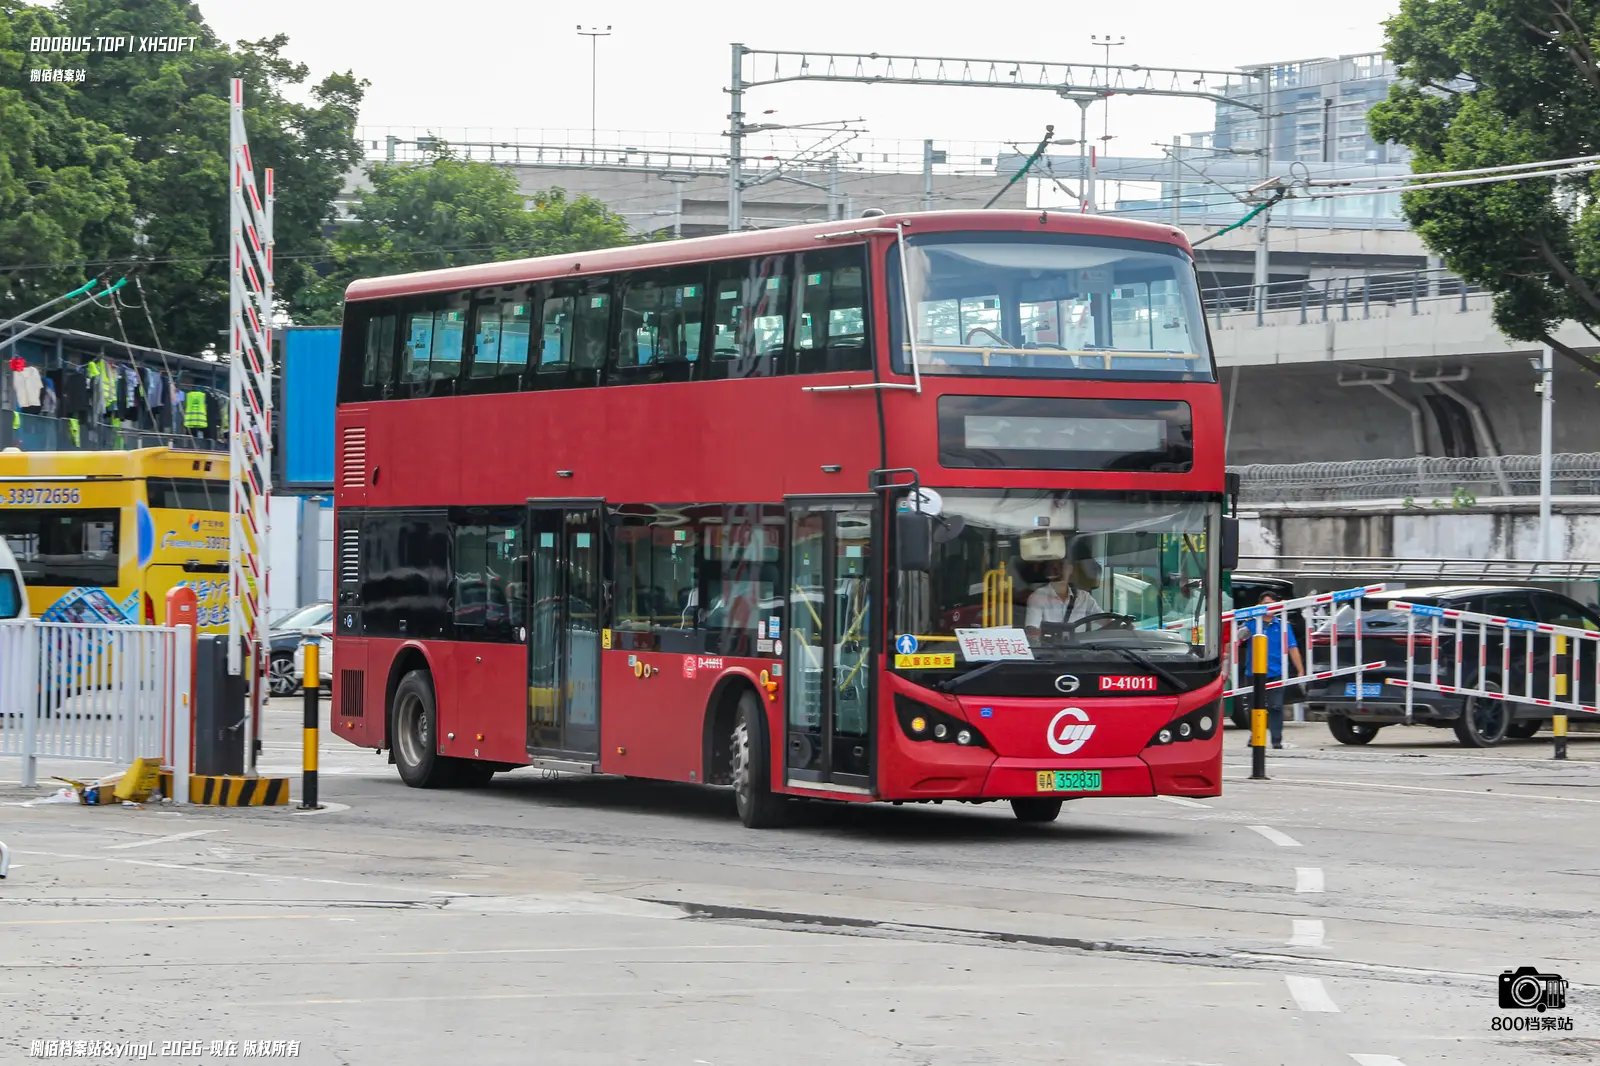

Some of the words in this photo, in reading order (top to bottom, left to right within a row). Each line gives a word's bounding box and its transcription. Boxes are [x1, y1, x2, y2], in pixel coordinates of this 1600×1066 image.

[965, 638, 1029, 656] 暂停营运
[1102, 677, 1153, 689] D-41011
